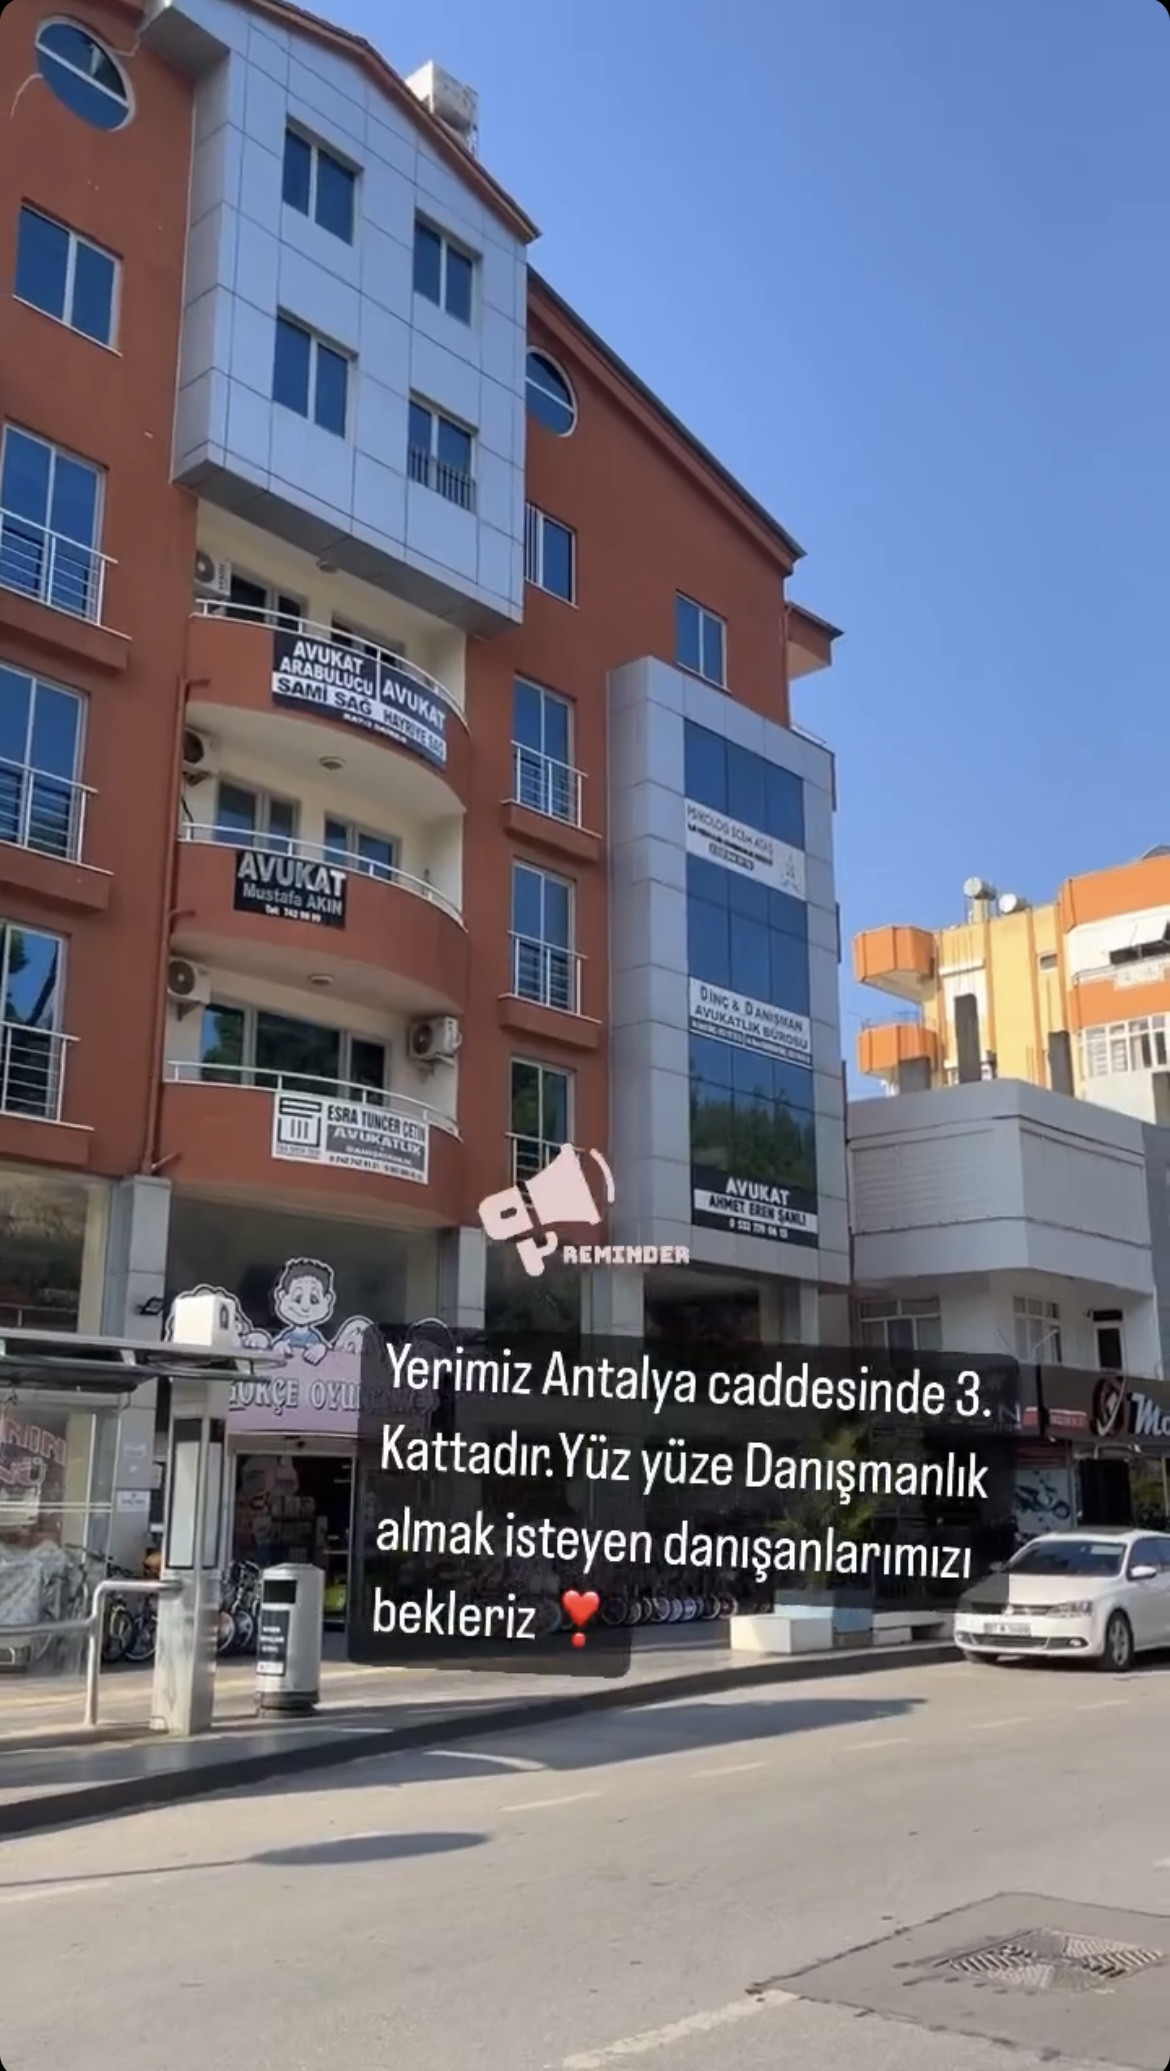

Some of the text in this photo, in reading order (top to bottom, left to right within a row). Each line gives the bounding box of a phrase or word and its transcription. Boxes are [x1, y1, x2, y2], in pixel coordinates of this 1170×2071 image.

[293, 641, 363, 675] AVUKAT
[279, 657, 373, 696] ARABULUCU
[383, 678, 446, 731] AVUKAT
[237, 852, 347, 897] AVUKAT
[243, 882, 342, 916] Mustafa AKIN
[695, 1004, 761, 1035] AVUKATLIK
[732, 999, 740, 1011] &
[327, 1104, 358, 1124] ESRA
[361, 1111, 400, 1133] TUNCER
[709, 1194, 745, 1214] AHMET
[750, 1201, 774, 1220] EREN
[726, 1176, 790, 1206] AVUKAT
